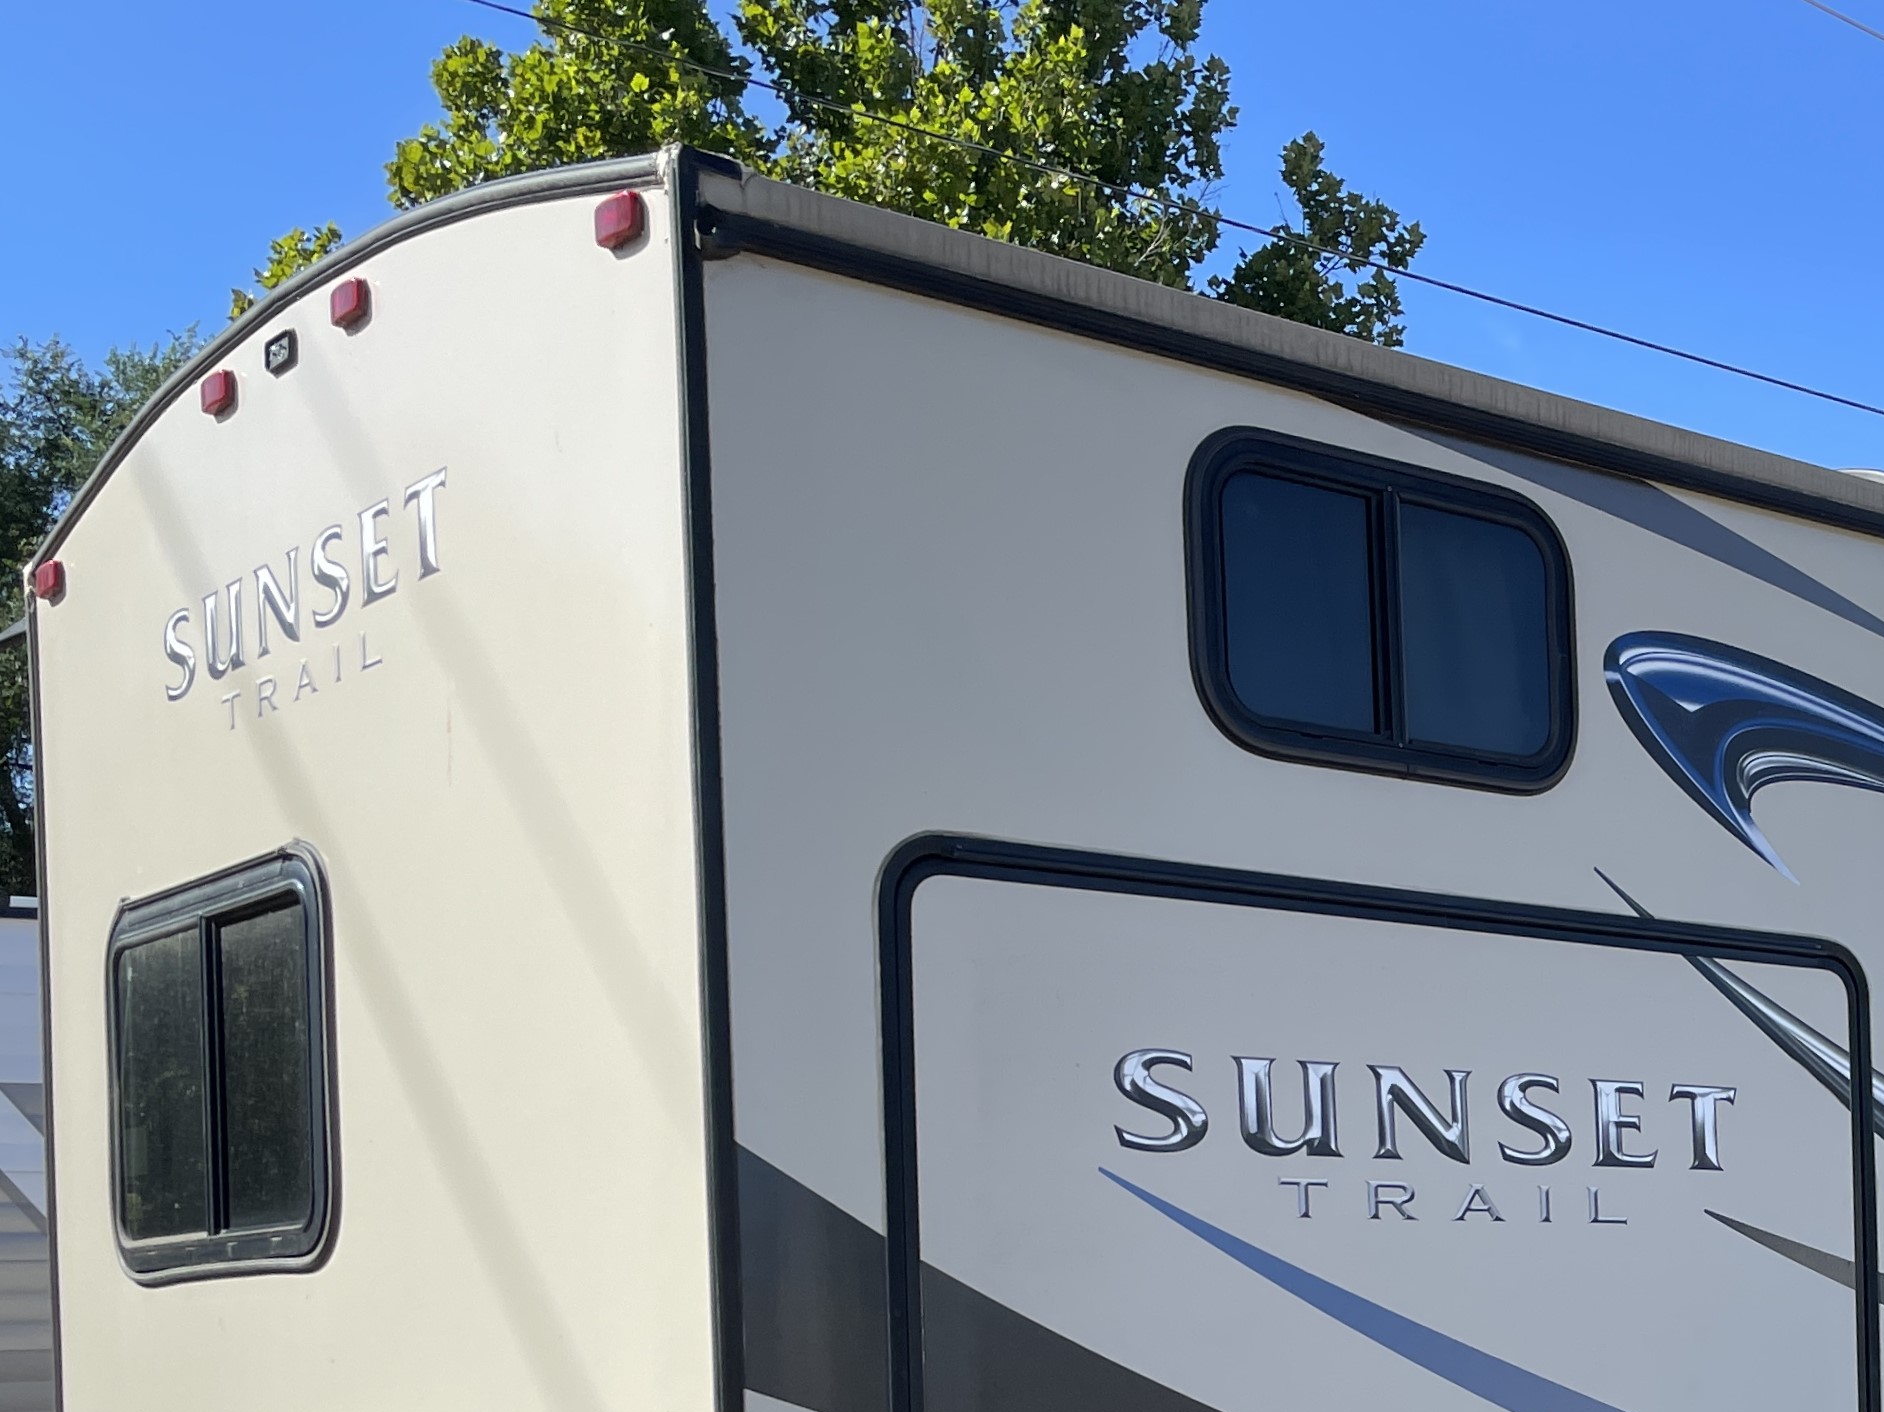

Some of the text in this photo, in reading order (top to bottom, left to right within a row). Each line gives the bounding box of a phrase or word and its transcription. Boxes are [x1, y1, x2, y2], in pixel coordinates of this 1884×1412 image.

[164, 466, 447, 701] SUNSET
[221, 631, 382, 730] TRAIL
[1113, 1047, 1737, 1171] SUNSET
[1278, 1176, 1628, 1225] TRAIL
